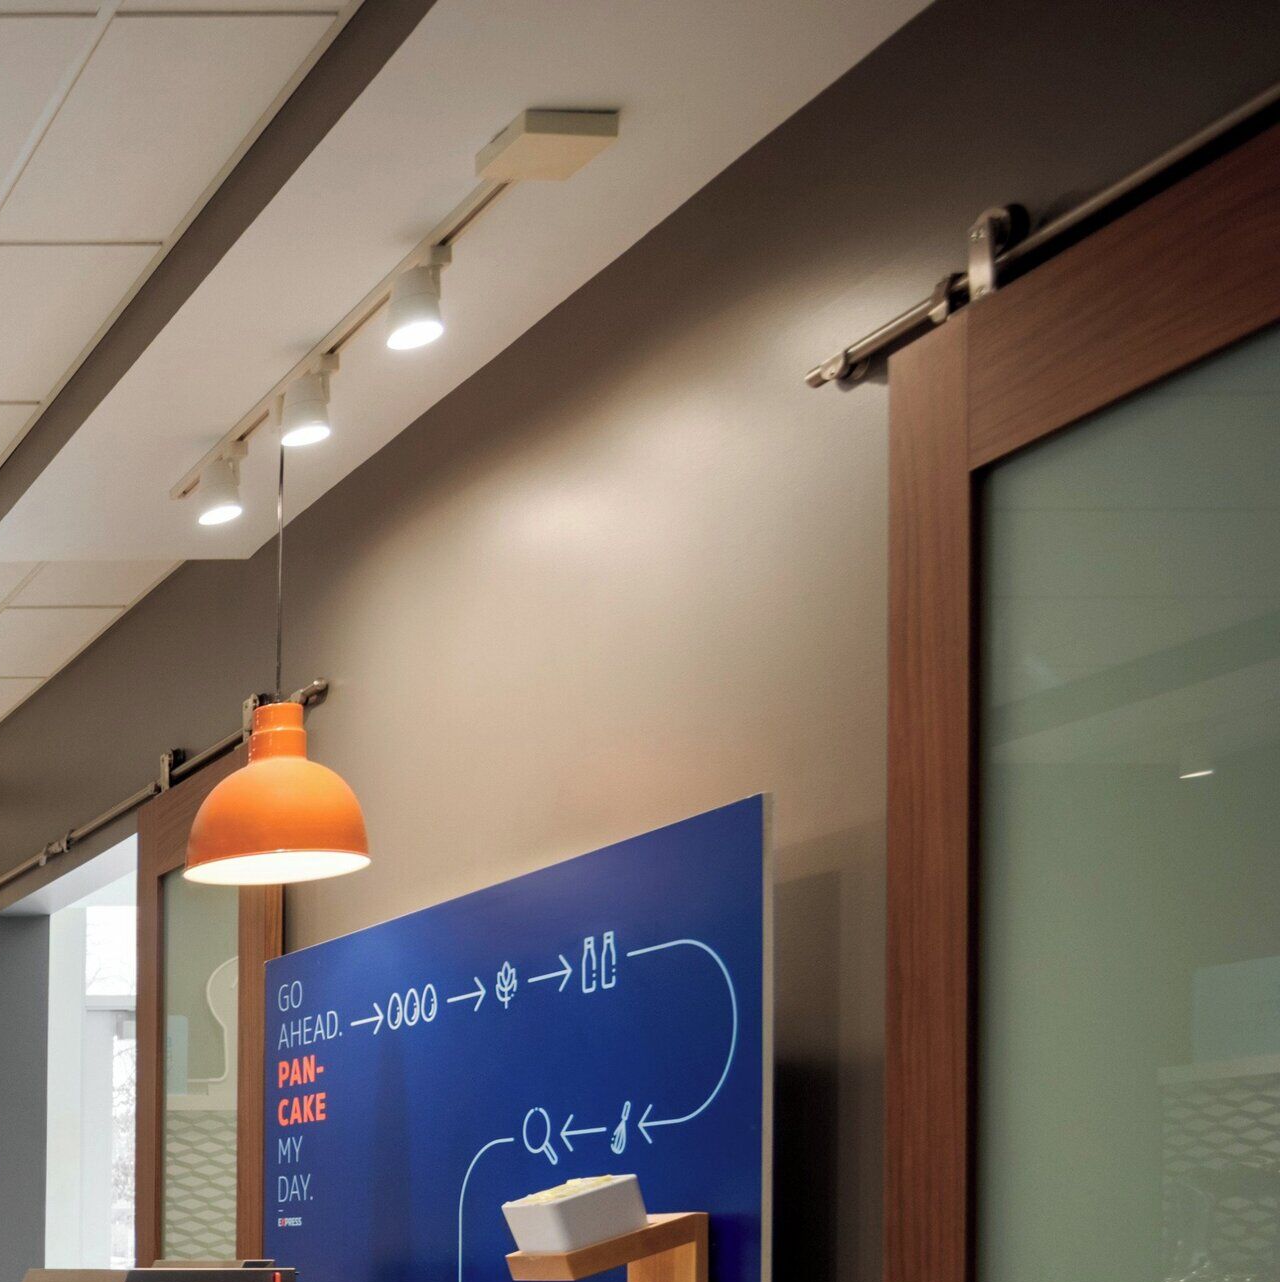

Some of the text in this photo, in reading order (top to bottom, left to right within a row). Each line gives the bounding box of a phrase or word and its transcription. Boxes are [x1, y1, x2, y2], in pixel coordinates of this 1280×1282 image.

[278, 980, 303, 1012] GO
[278, 1010, 343, 1050] AHEAD.
[278, 1054, 324, 1088] PAN-
[278, 1092, 327, 1127] CAKE
[278, 1135, 303, 1164] MY
[278, 1173, 314, 1203] DAY.
[278, 1217, 302, 1227] EXPRESS
